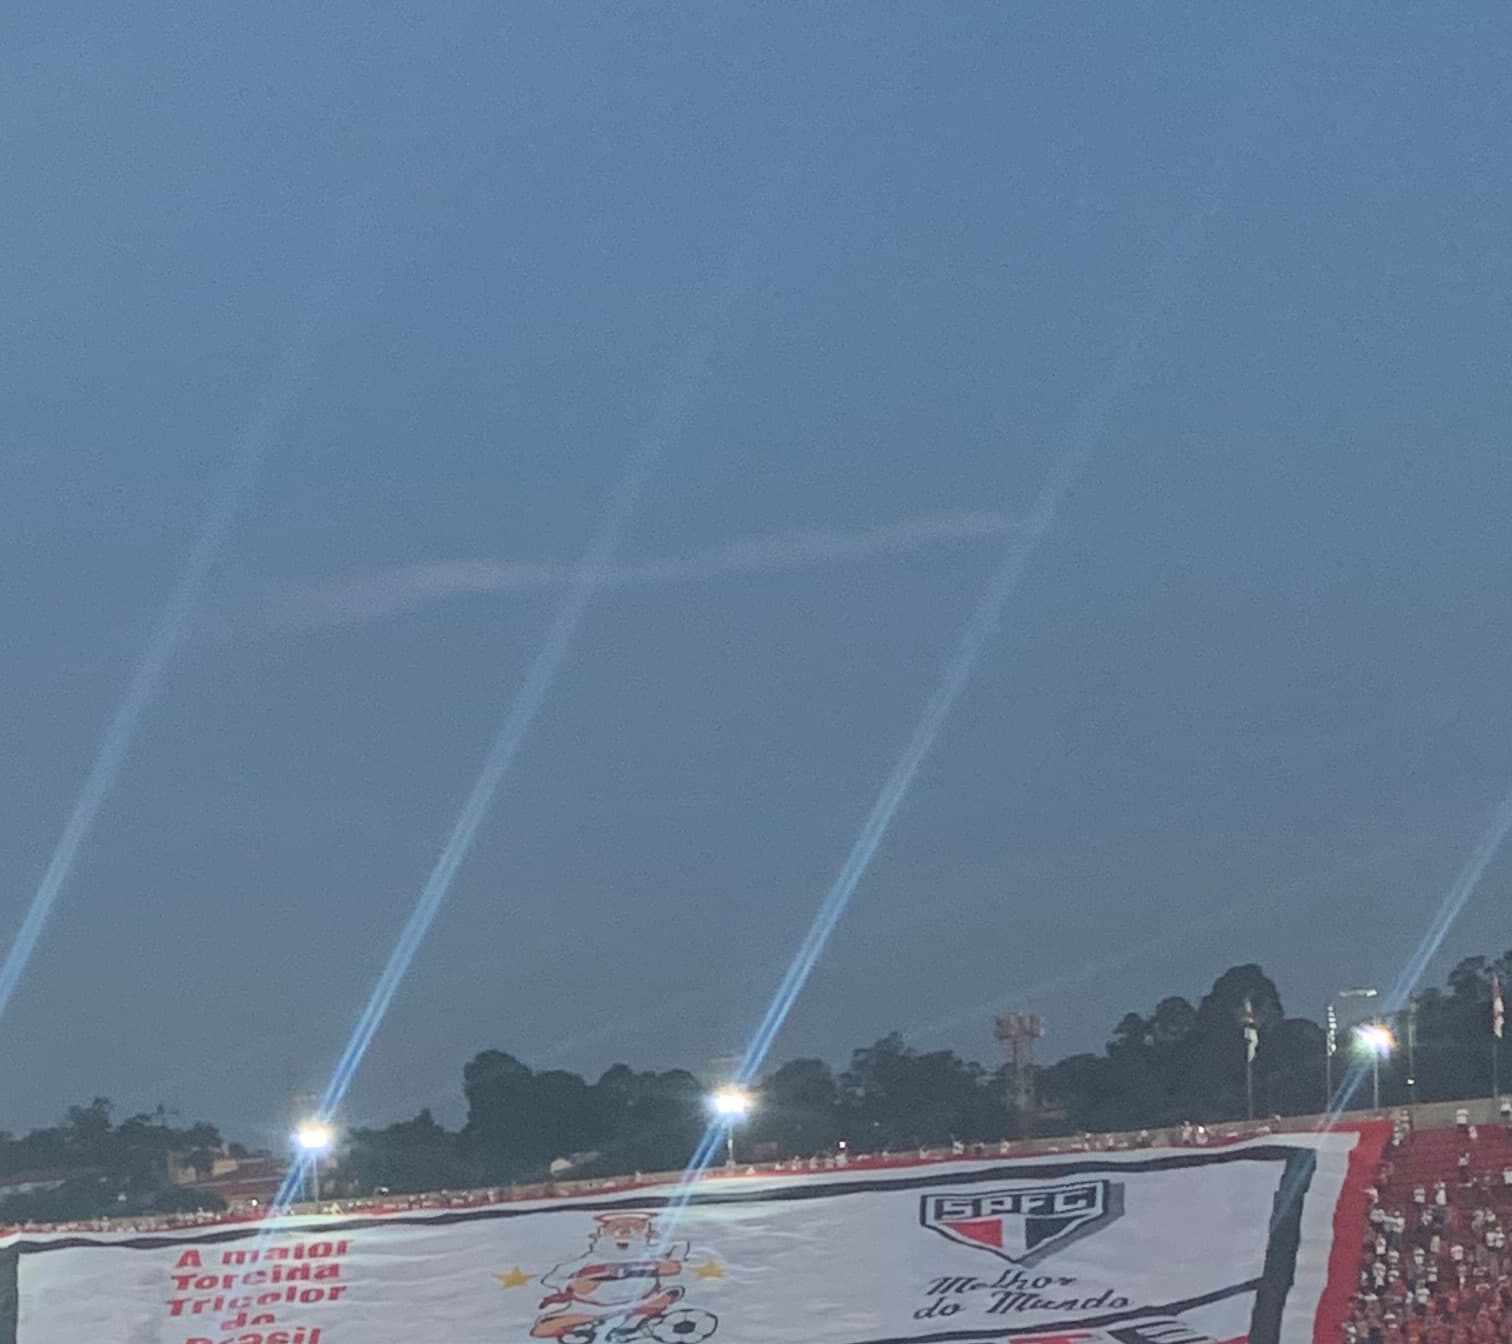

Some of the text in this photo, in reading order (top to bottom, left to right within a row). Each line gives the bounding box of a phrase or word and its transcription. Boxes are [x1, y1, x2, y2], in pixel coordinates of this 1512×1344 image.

[940, 1186, 1098, 1217] SPFC
[176, 1239, 354, 1268] A maior
[926, 1269, 1077, 1295] Melhor
[166, 1285, 348, 1316] Tricolor
[913, 1289, 1130, 1320] do Mundo
